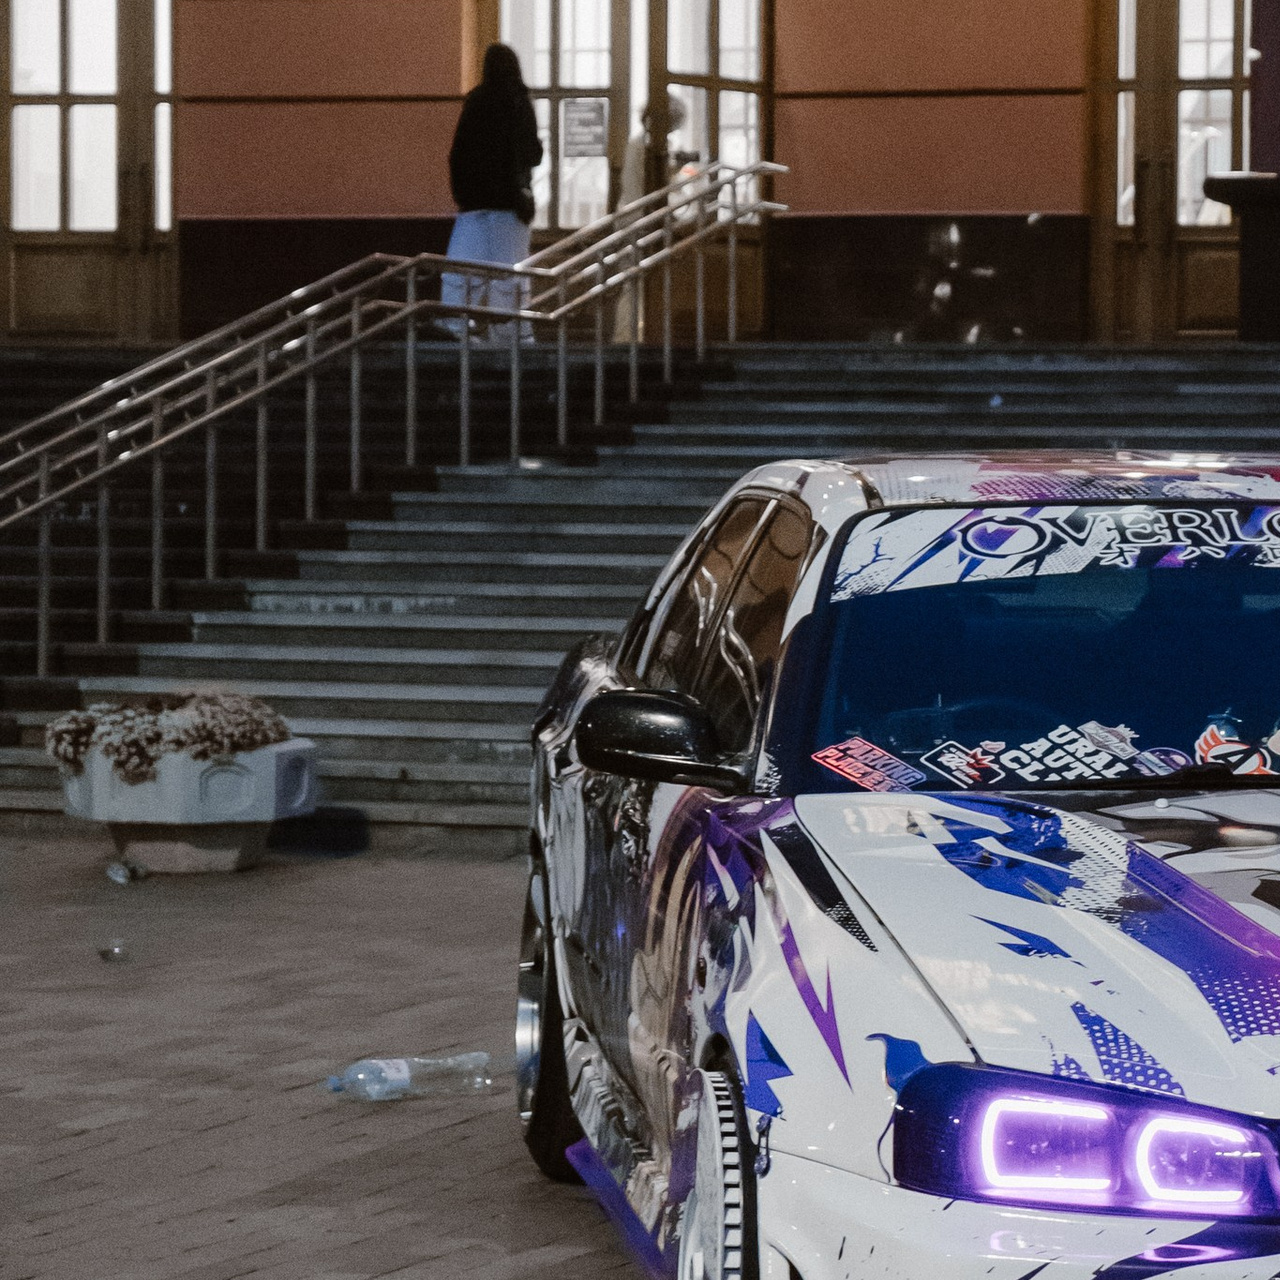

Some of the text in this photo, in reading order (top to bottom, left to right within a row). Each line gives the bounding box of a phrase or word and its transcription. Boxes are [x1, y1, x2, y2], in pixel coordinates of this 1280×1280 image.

[814, 748, 875, 784] PLACE
[836, 737, 924, 787] PARKING
[1020, 741, 1102, 780] AUT
[1047, 725, 1129, 778] URAL
